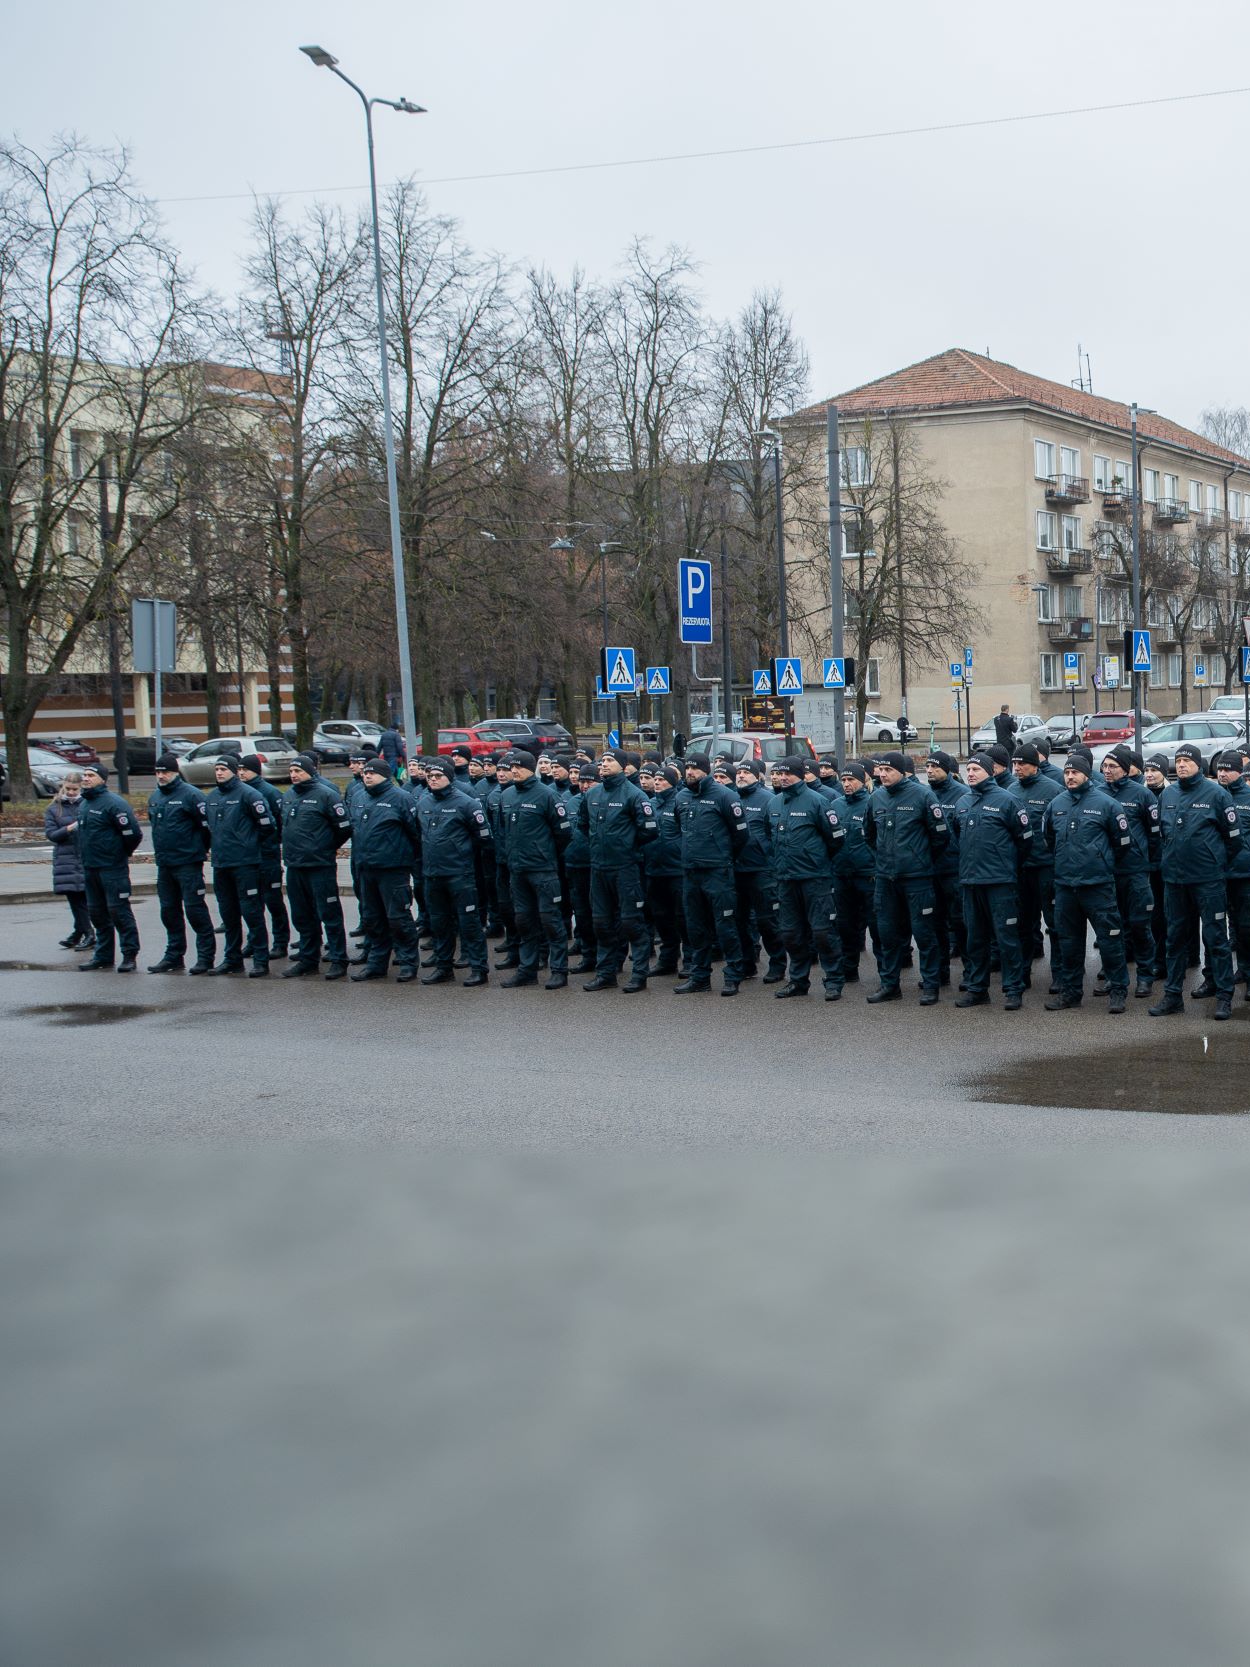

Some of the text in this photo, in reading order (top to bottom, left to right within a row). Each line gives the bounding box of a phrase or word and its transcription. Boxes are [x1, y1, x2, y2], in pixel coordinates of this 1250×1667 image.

[688, 566, 705, 608] P
[1068, 655, 1076, 666] P
[953, 664, 961, 675] P
[1197, 666, 1203, 675] P
